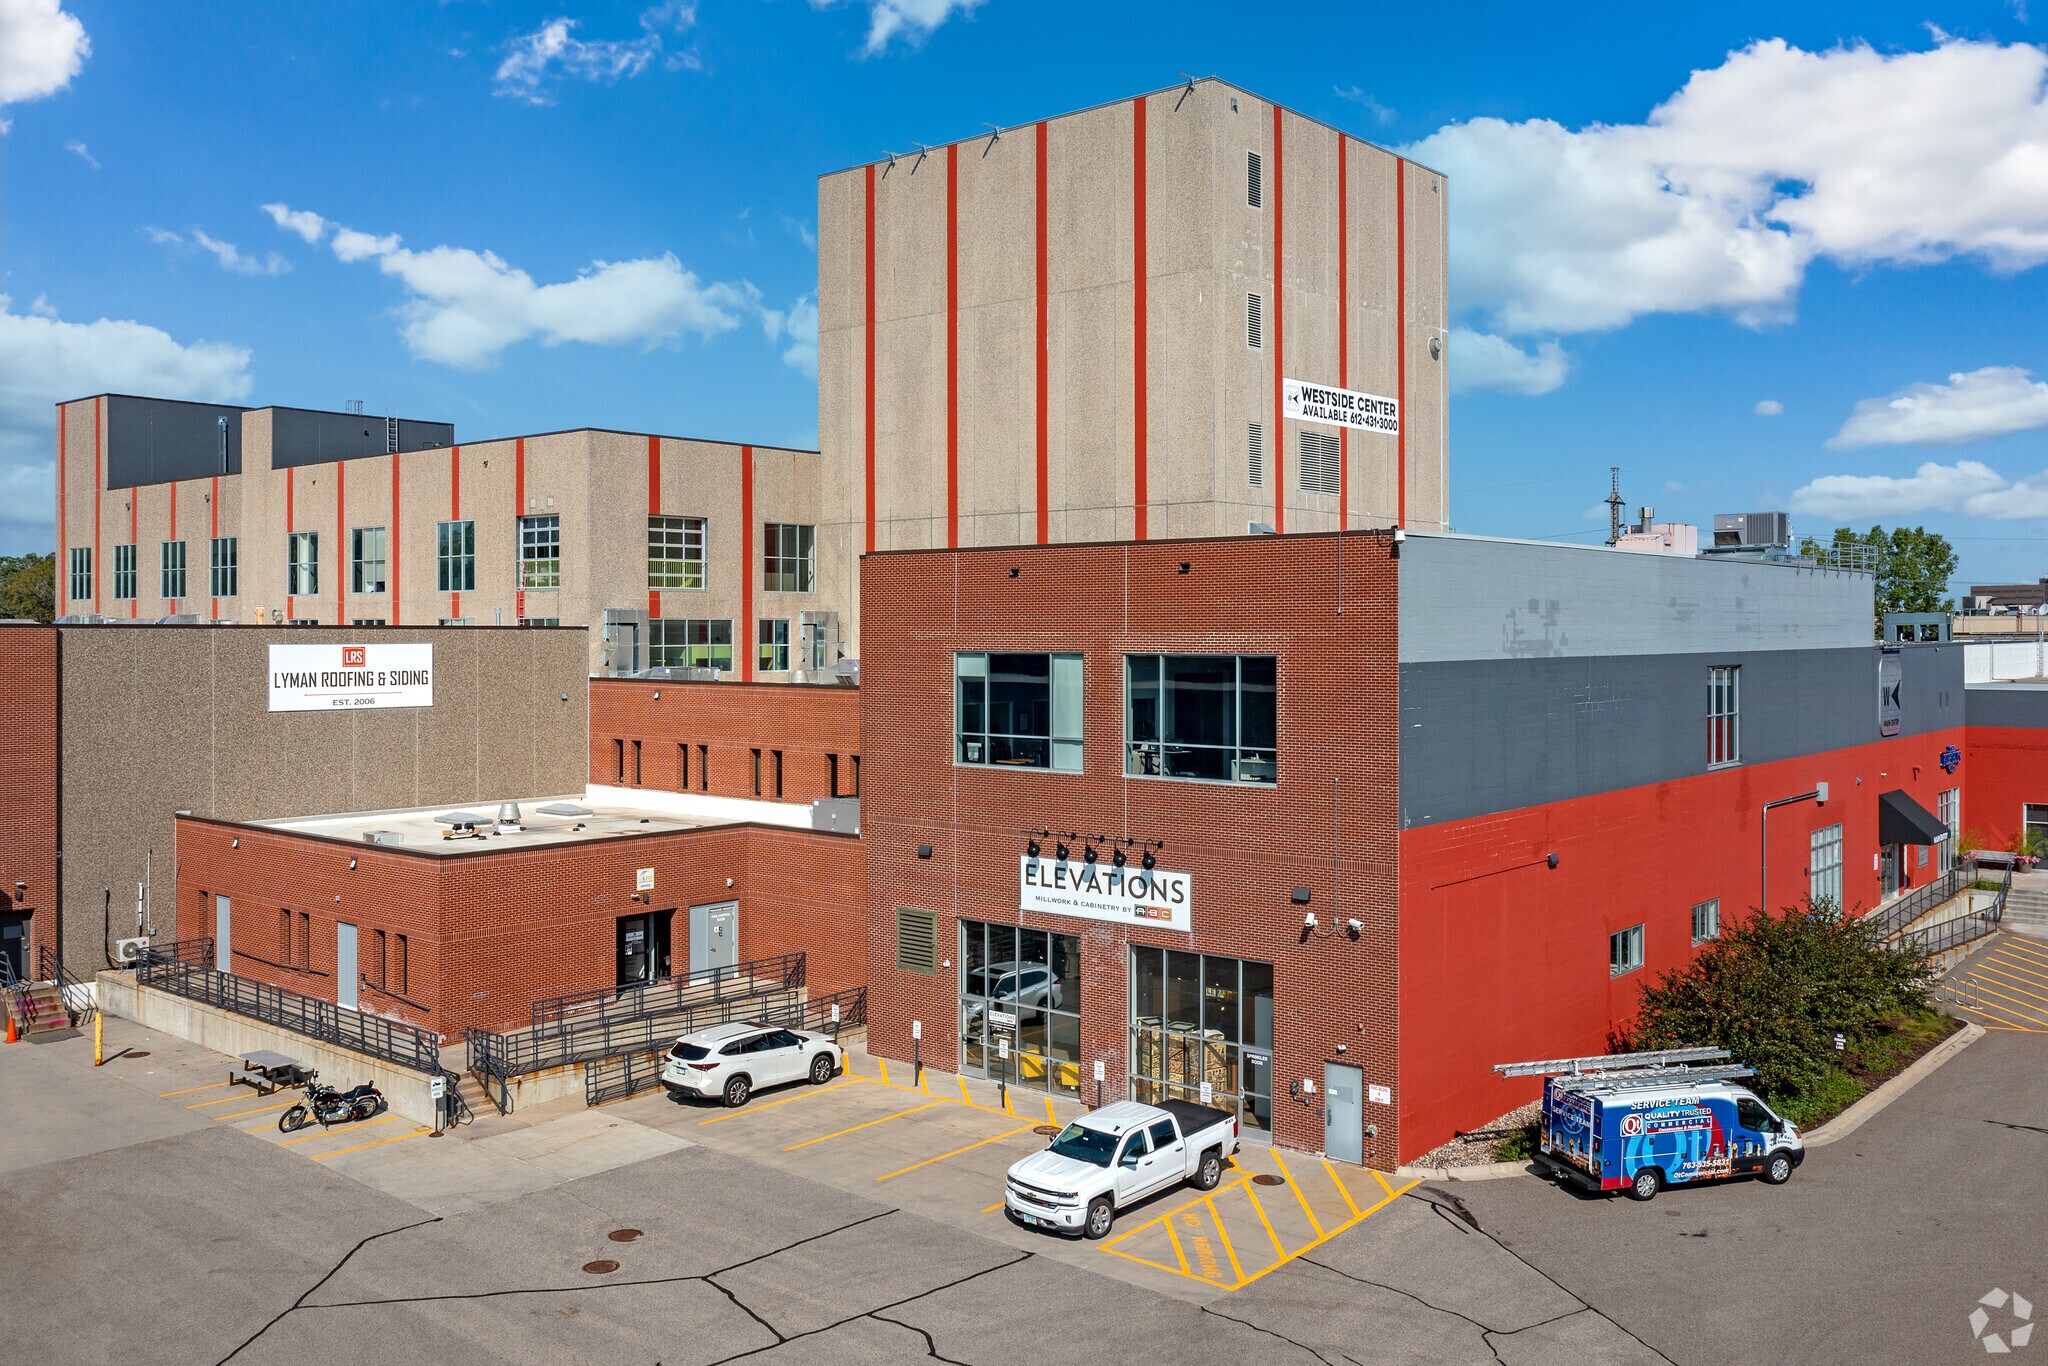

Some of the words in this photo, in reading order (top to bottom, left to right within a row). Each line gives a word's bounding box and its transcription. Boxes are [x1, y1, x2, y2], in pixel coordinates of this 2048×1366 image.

[1301, 386, 1355, 409] WESTSIDE
[1357, 396, 1396, 417] CENTER
[1302, 404, 1348, 422] AVAILABLE
[345, 651, 363, 664] LRS
[274, 672, 317, 689] LYMAN
[321, 671, 374, 688] ROOFING
[378, 671, 386, 686] &
[390, 670, 429, 686] SIDING
[353, 698, 376, 706] 2006
[1025, 863, 1185, 904] ELEVATIONS
[1035, 895, 1071, 906] MILLWORK
[1080, 901, 1120, 912] CABINETRY
[1246, 1053, 1268, 1061] SPRINKLER
[1630, 1098, 1672, 1110] SERVICE
[1674, 1095, 1701, 1106] TEAM
[1552, 1105, 1575, 1121] SERVICE
[1575, 1116, 1591, 1128] TEAM
[1644, 1110, 1681, 1120] QUALITY
[1681, 1107, 1712, 1117] TRUSTED
[1624, 1117, 1641, 1134] Qt
[1646, 1117, 1711, 1129] COMMERCIAL
[1682, 1158, 1730, 1170] 763-535-5831
[1182, 1213, 1201, 1227] NO
[1191, 1235, 1222, 1278] PARKING
